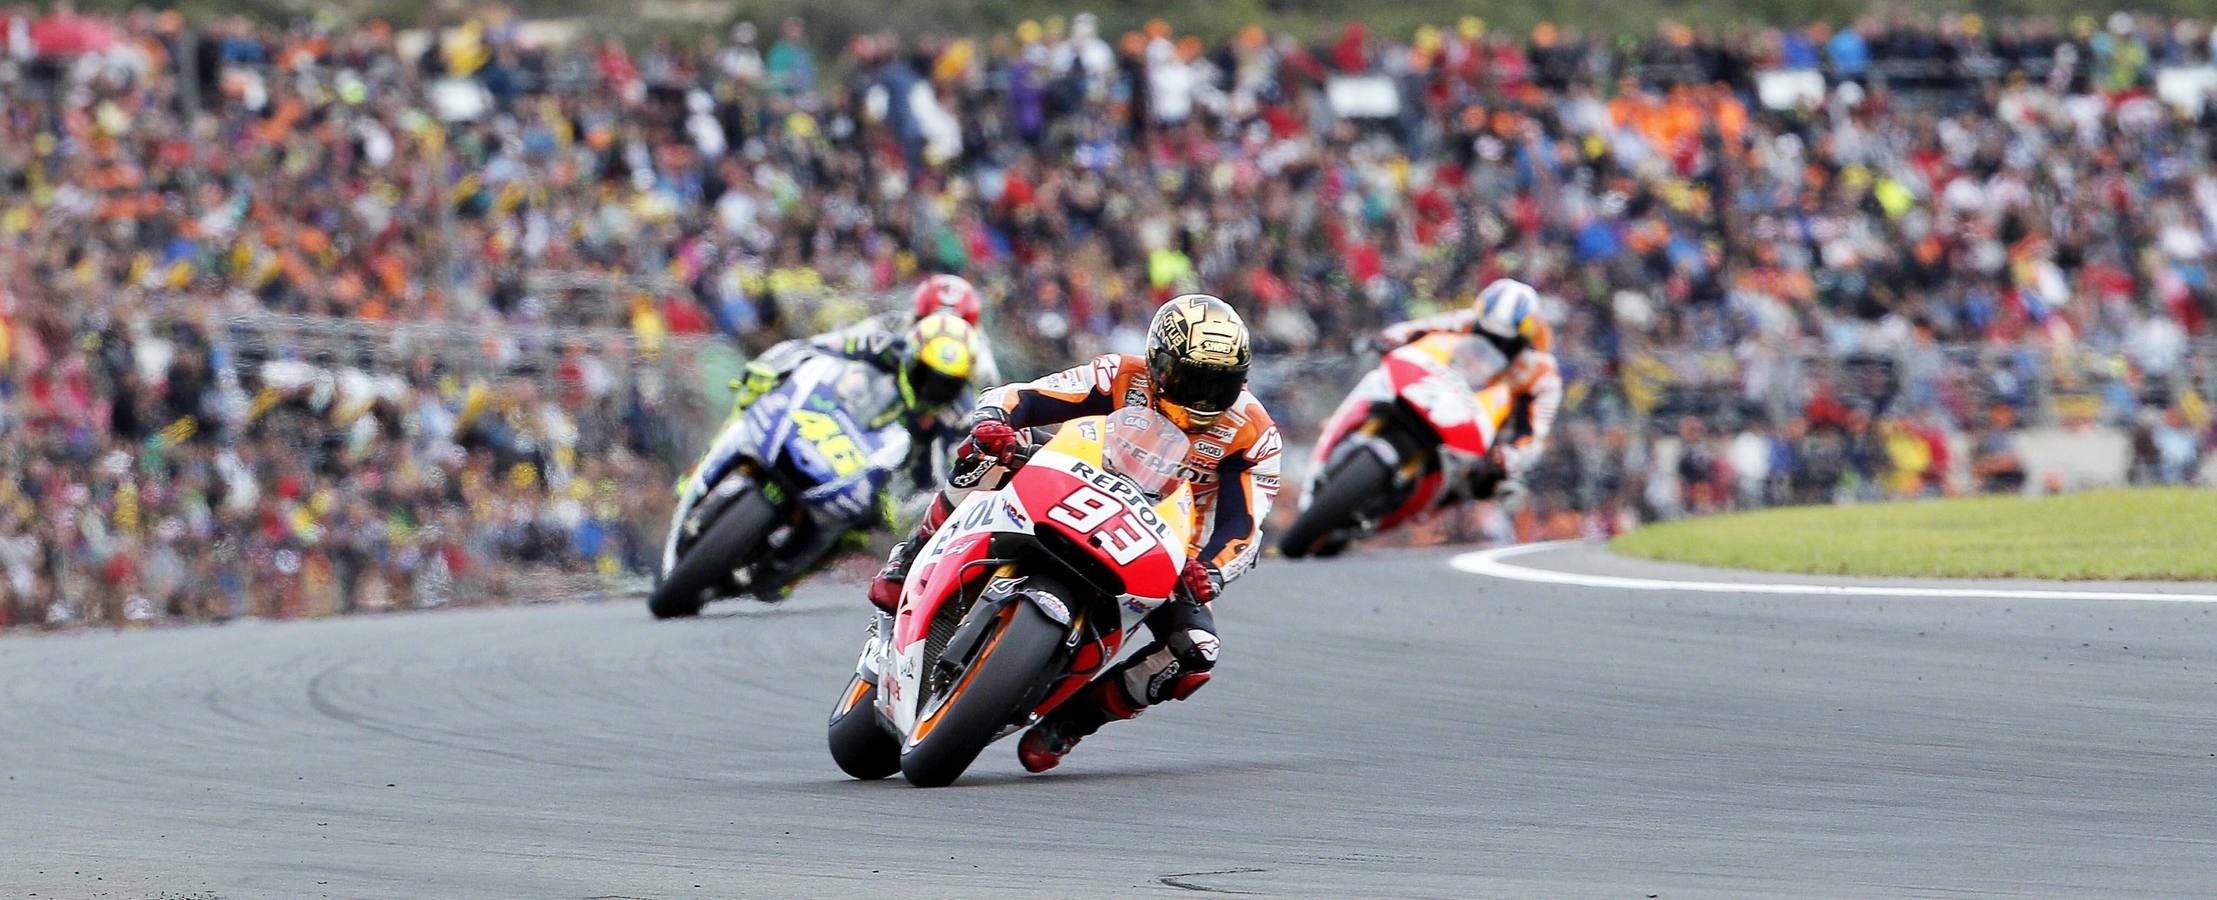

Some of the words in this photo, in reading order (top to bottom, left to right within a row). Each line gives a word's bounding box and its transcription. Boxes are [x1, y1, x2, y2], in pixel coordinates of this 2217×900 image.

[1204, 340, 1231, 353] SHOEI
[788, 409, 866, 476] 46
[1125, 416, 1150, 429] GAS
[1198, 442, 1221, 457] SHOEI
[1070, 462, 1166, 539] REPSOL
[1047, 485, 1159, 566] 93
